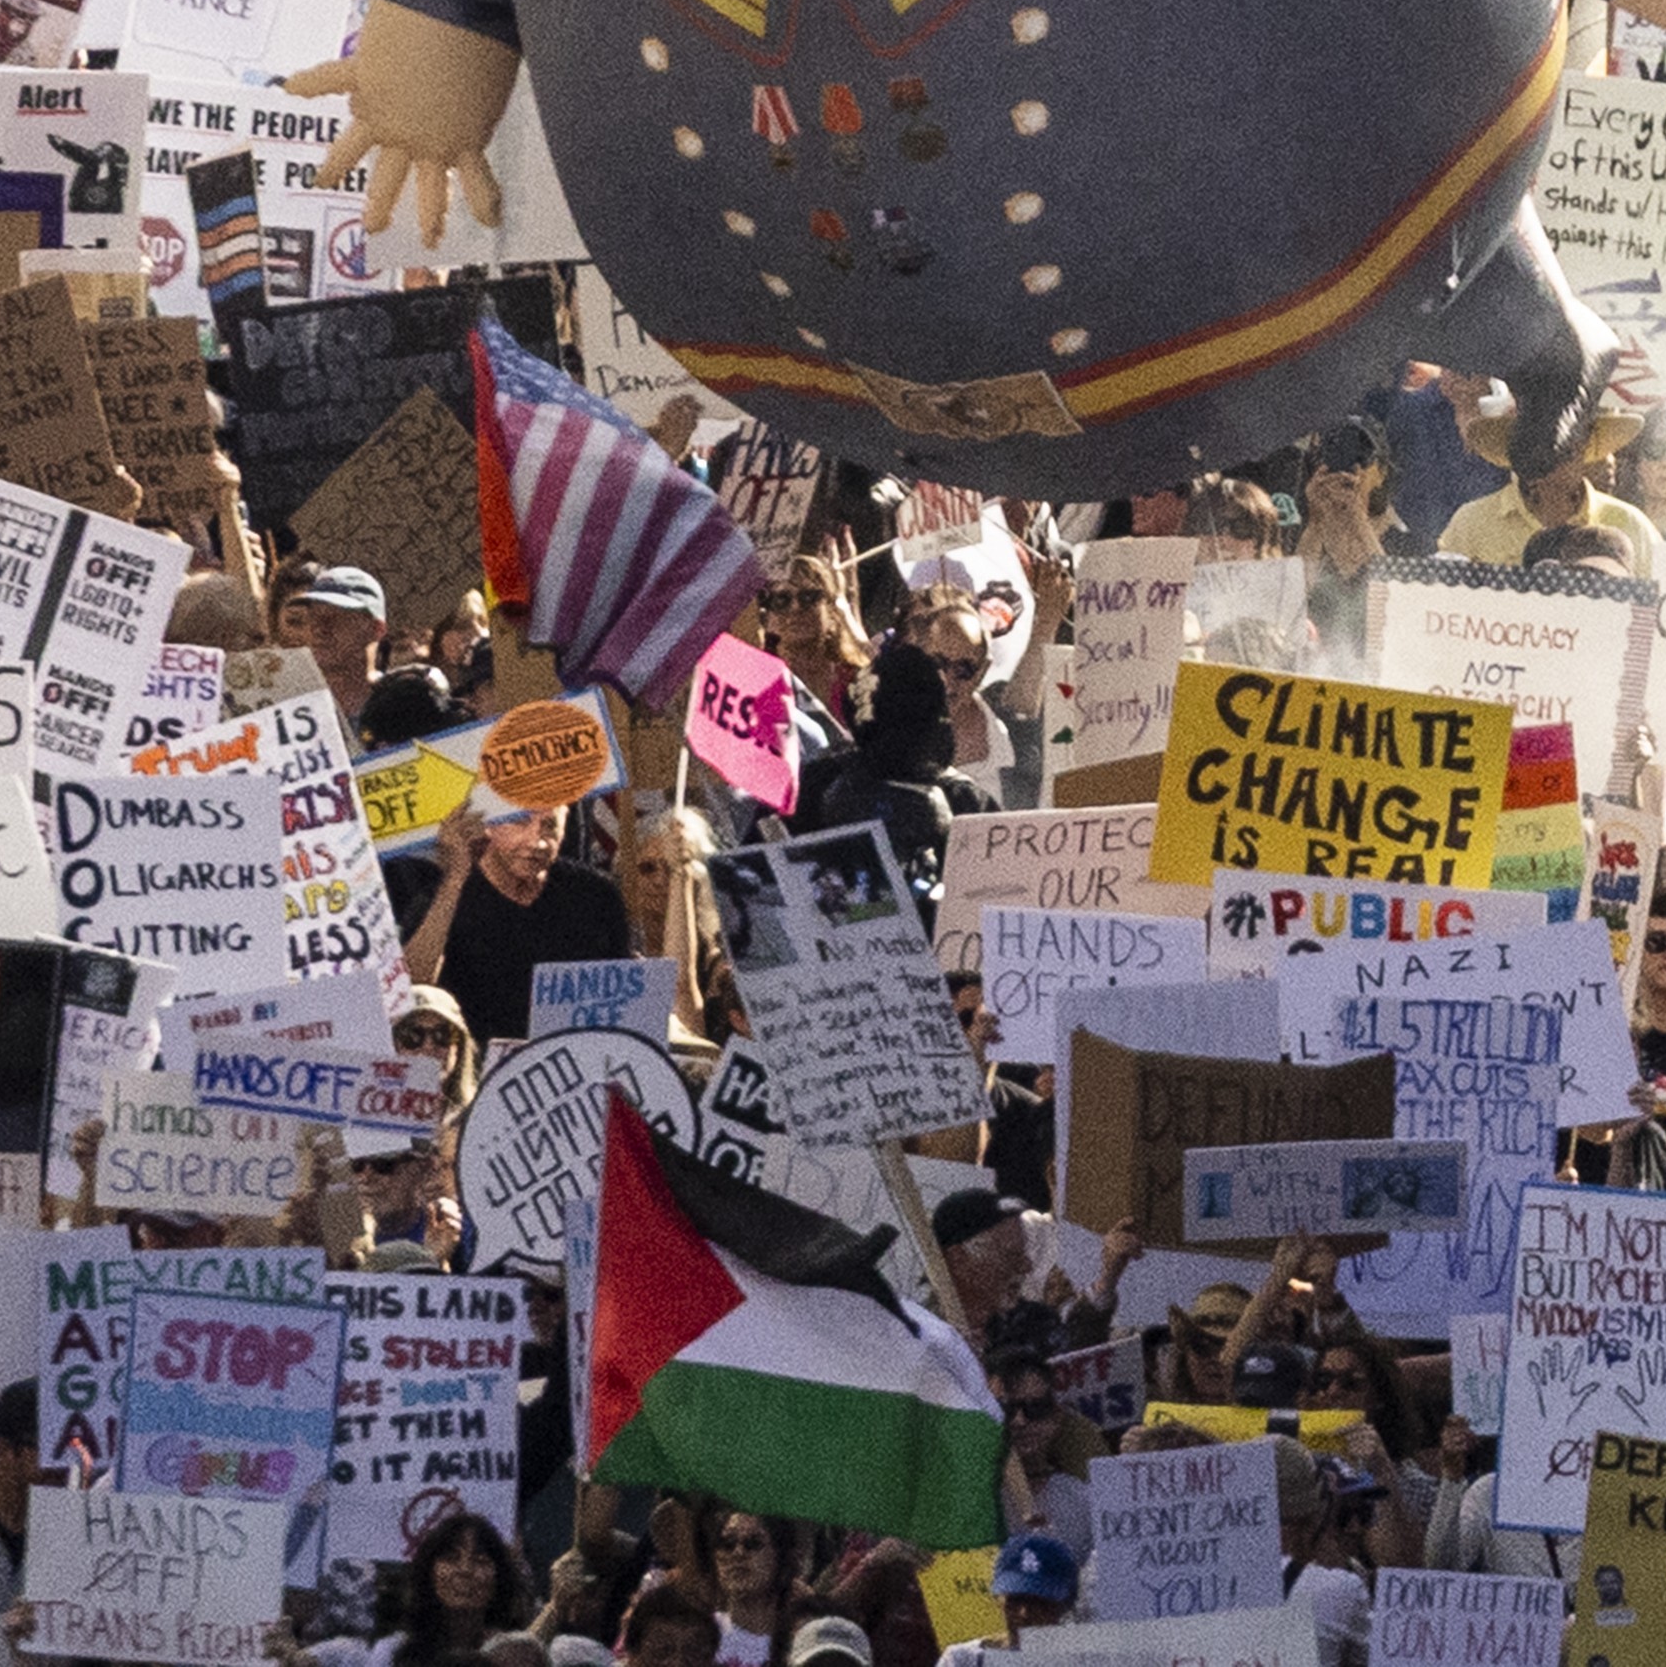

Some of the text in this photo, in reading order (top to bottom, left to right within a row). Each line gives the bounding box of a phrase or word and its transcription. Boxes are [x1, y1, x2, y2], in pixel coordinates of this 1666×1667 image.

[19, 85, 84, 113] Alert
[191, 104, 236, 133] THE
[1215, 672, 1476, 770] CLIMATE
[482, 726, 596, 778] DEMOCRACY
[59, 784, 243, 852] DUMBASS
[1187, 748, 1483, 848] CHANGE
[63, 862, 278, 906] OLIGARCHS
[1222, 891, 1476, 941] #PUBLIC
[383, 1337, 515, 1371] STOLEN
